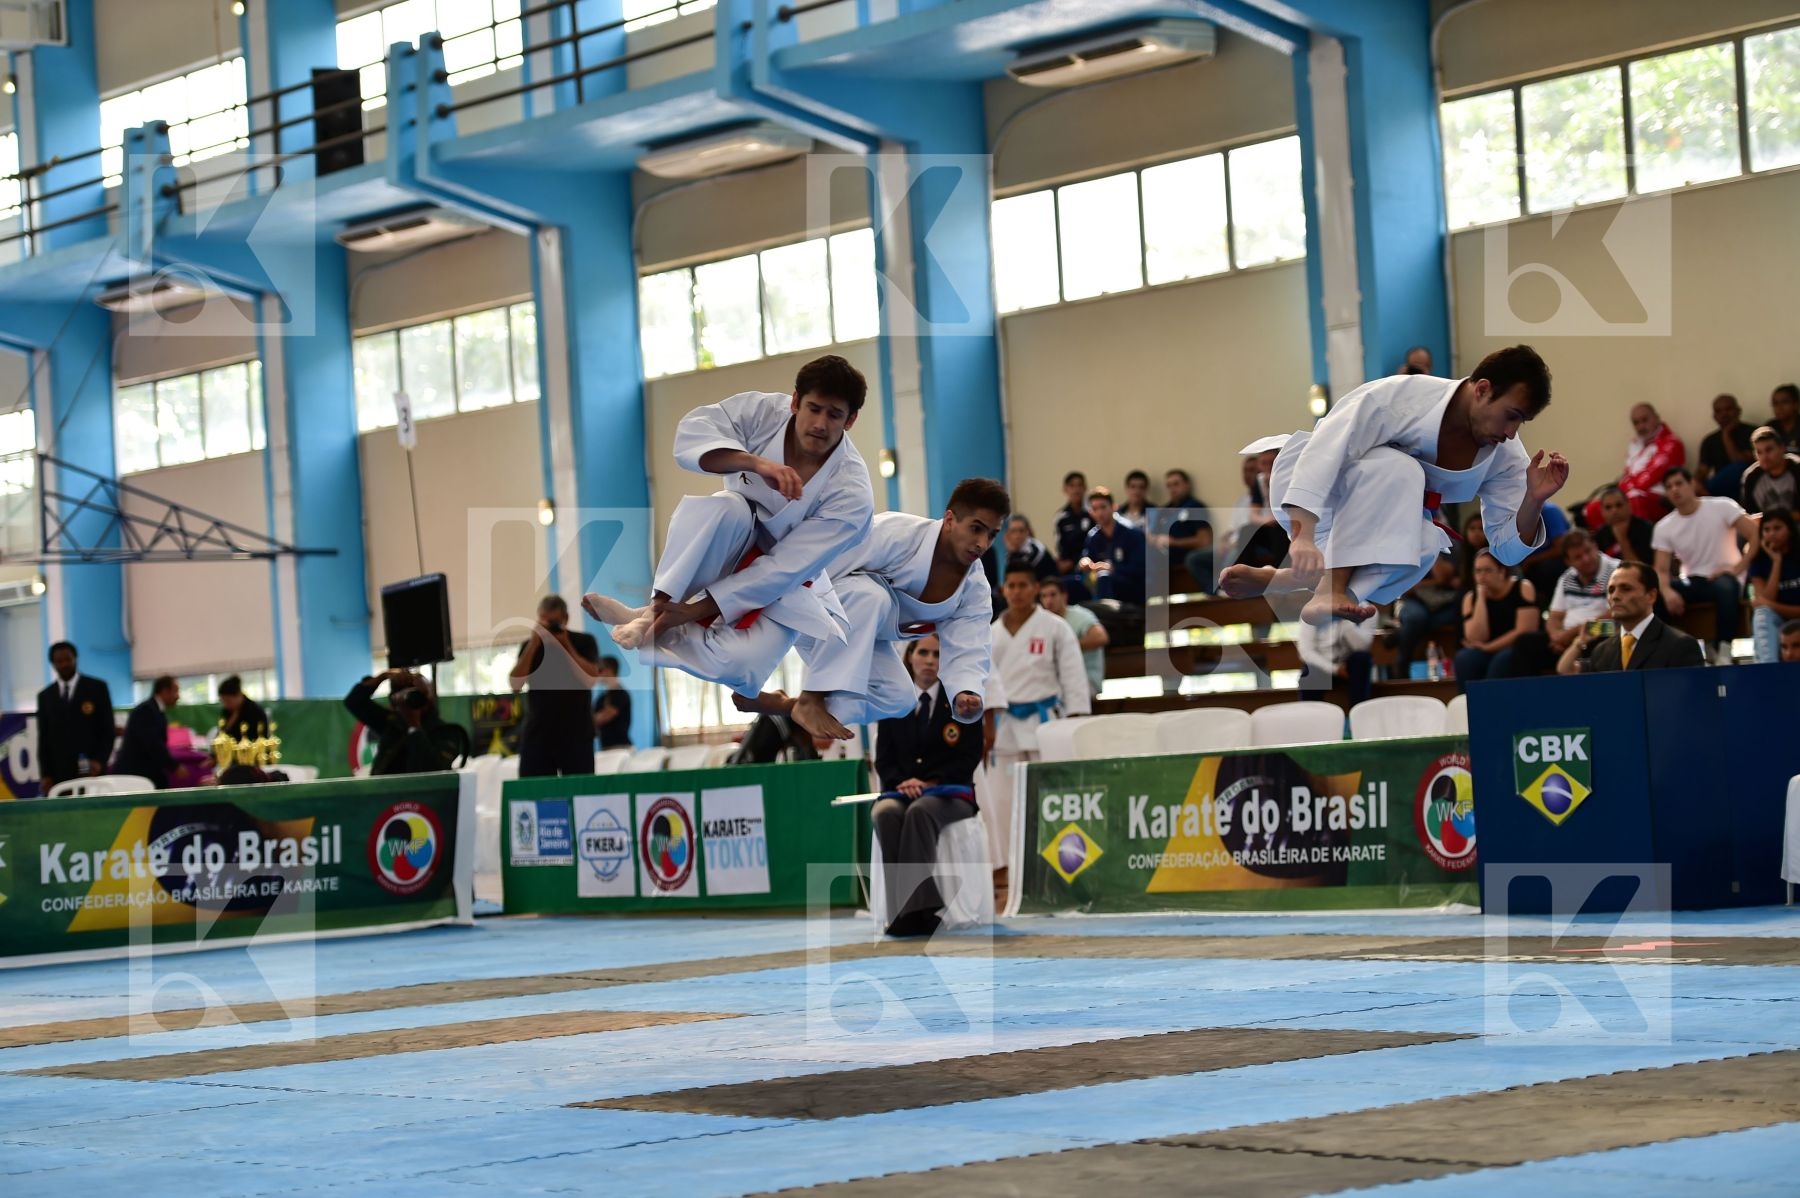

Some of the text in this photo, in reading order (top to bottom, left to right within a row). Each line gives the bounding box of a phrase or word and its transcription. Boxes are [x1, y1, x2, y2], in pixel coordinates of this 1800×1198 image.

[1518, 734, 1588, 763] CBK
[1041, 792, 1104, 822] CBK
[1128, 781, 1388, 839] Karate do Brasil
[1436, 801, 1473, 822] WKF
[703, 818, 746, 838] KARATE
[40, 840, 169, 884] Karate
[182, 834, 225, 874] do
[238, 825, 342, 871] Brasil
[388, 839, 424, 857] WKF
[586, 837, 624, 853] FKERJ
[706, 836, 766, 870] TOKYO
[1128, 845, 1386, 870] CONFEDERAÇÃO BRASILEIRA DE KARATE
[41, 876, 339, 912] CONFEDERAÇÃO BRASILEIRA DE KARATE
